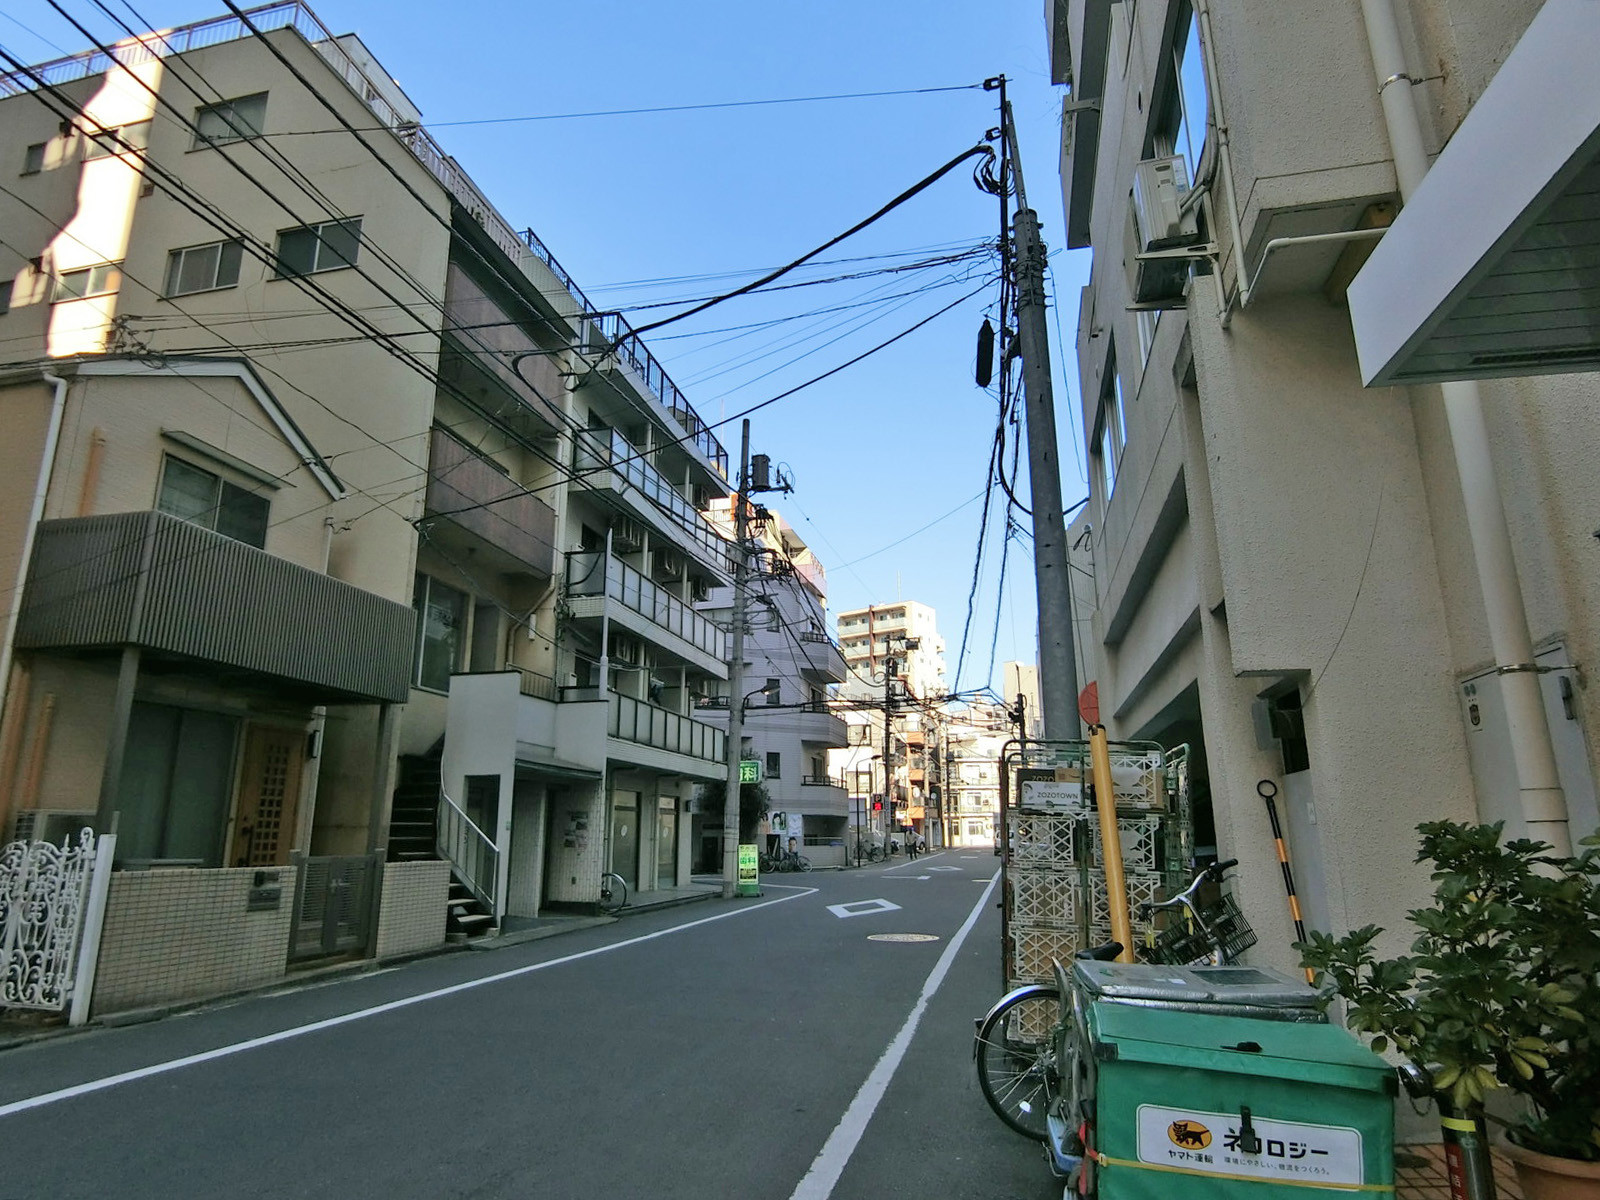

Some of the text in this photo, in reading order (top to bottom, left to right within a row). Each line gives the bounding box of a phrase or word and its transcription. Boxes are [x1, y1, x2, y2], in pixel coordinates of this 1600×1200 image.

[740, 766, 757, 781] 科
[1168, 1150, 1213, 1164] ヤマト運輸
